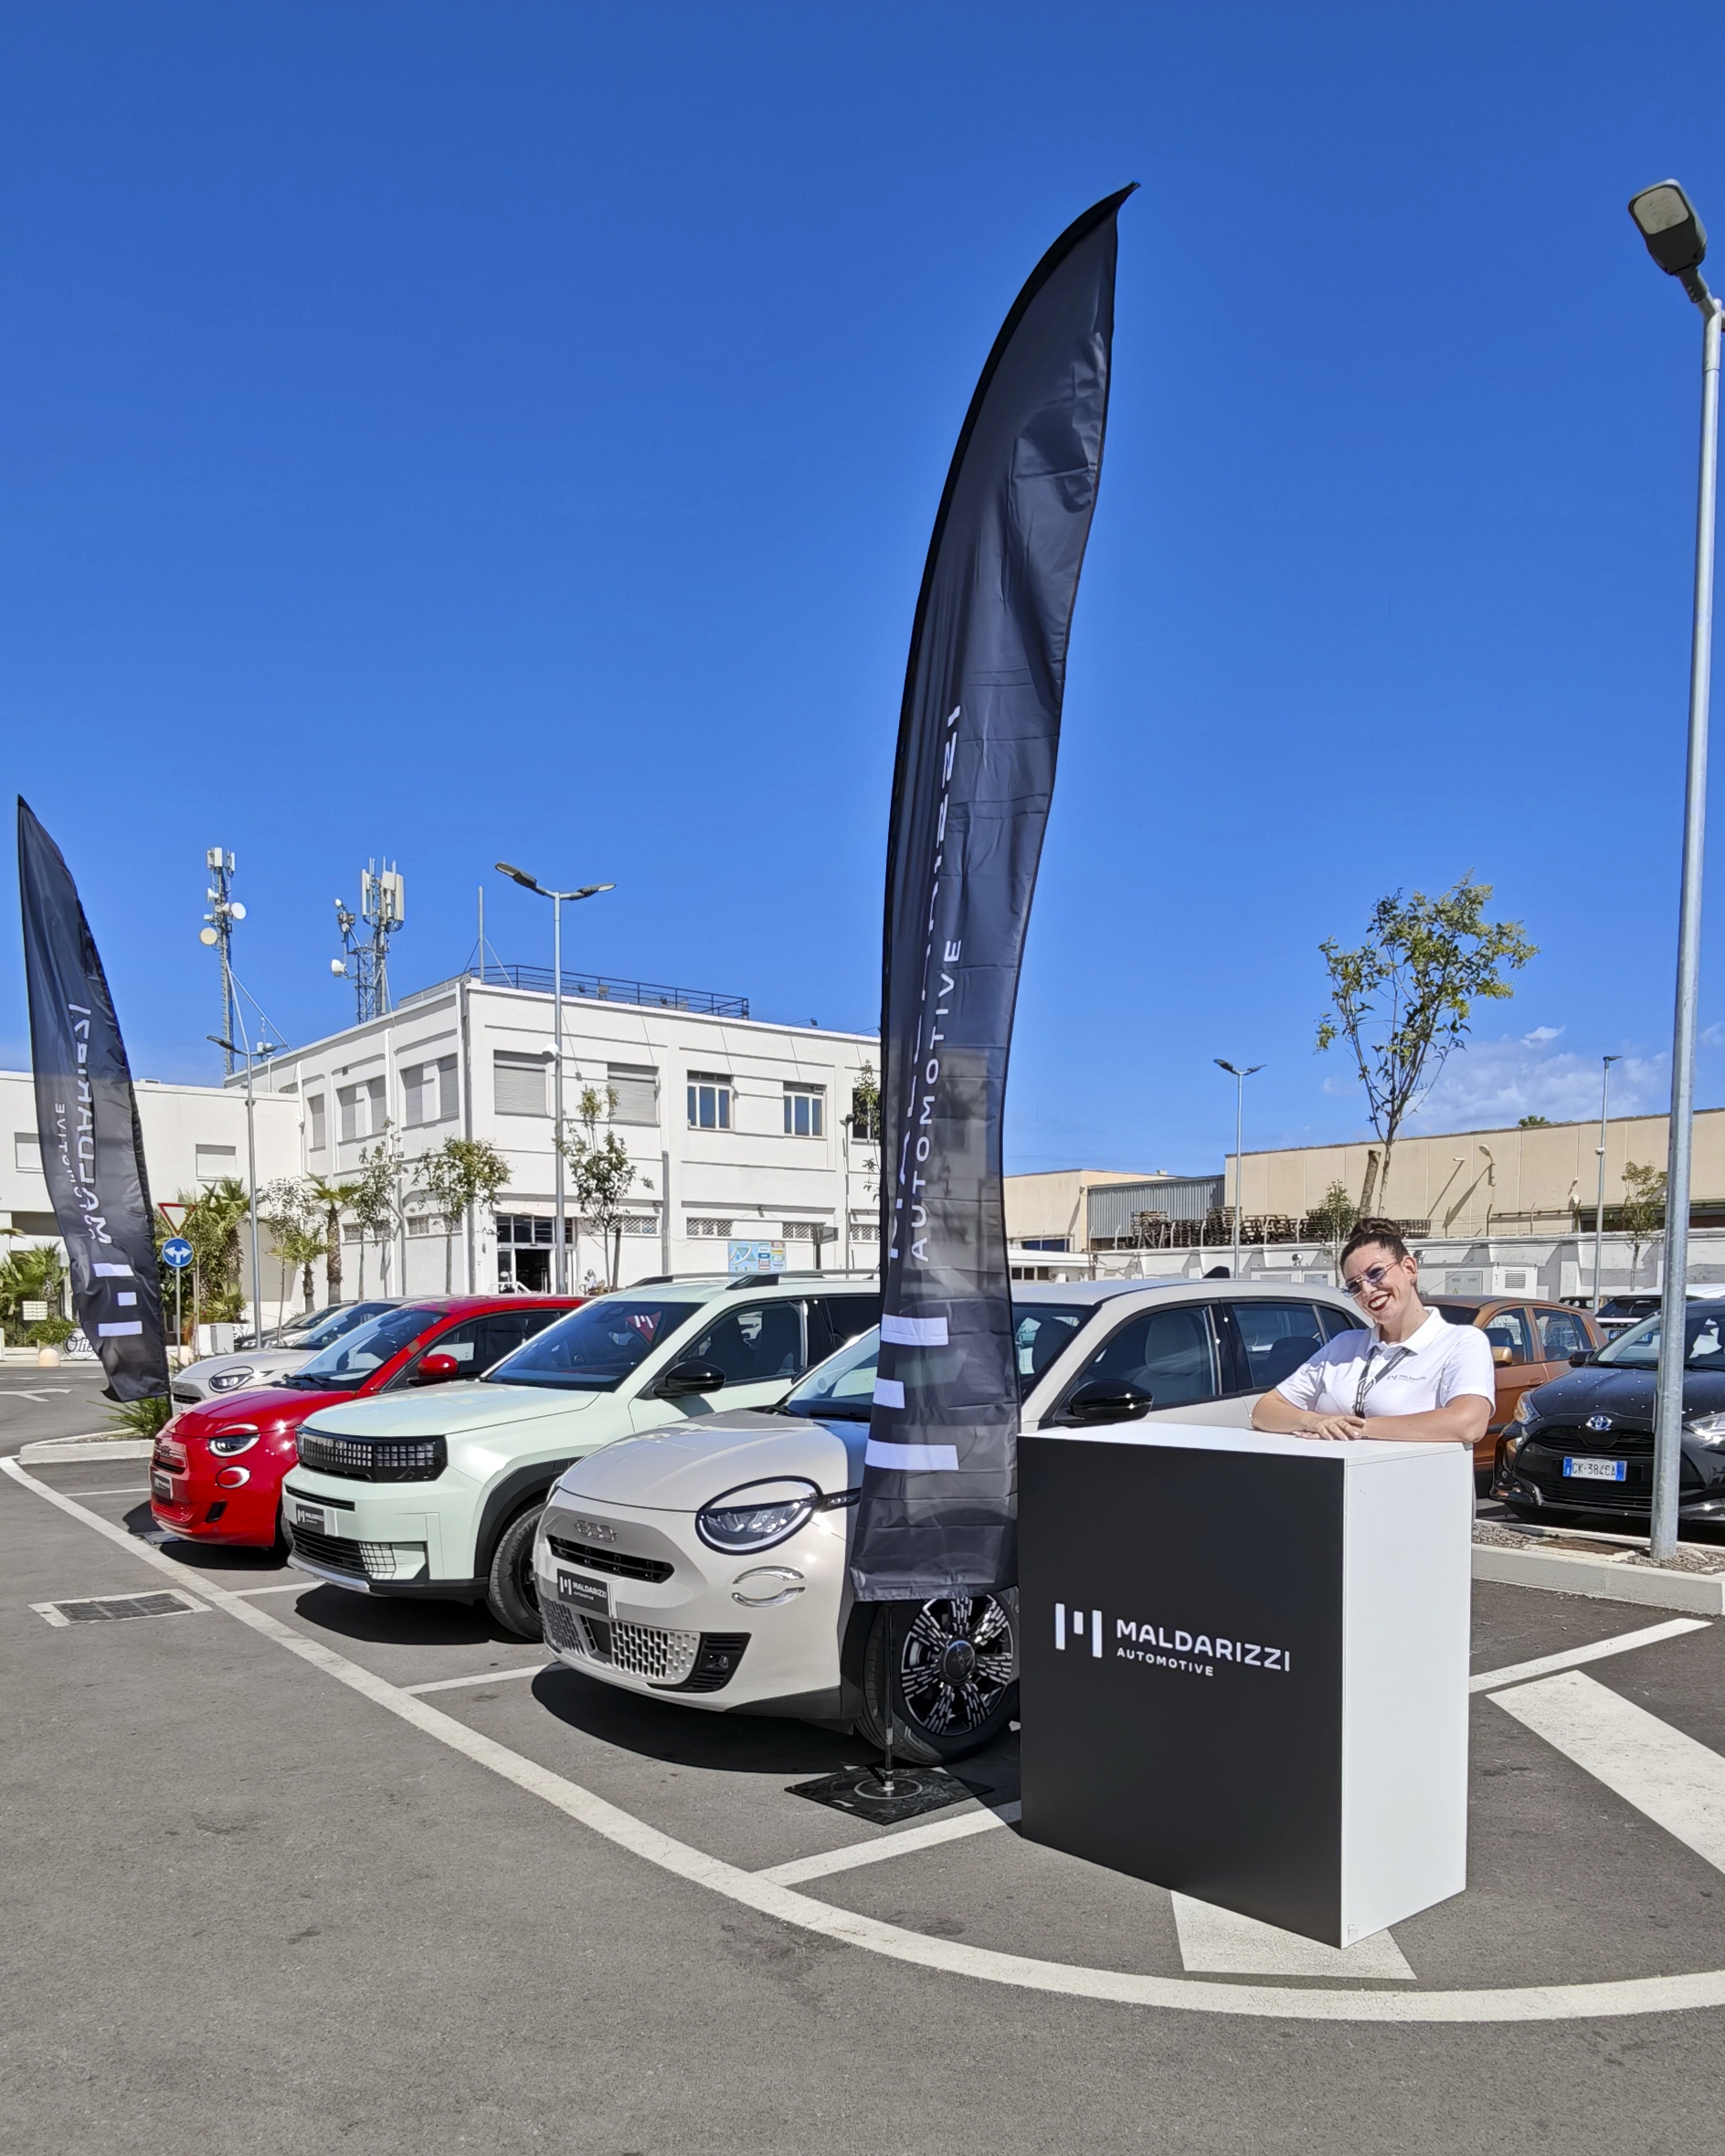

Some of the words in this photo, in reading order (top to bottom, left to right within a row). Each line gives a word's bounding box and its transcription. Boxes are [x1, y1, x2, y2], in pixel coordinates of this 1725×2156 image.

[911, 938, 962, 1263] AUTOMOTIVE
[1116, 1619, 1291, 1673] MALDARIZZI
[1116, 1647, 1215, 1677] AUTOMOTIVE
